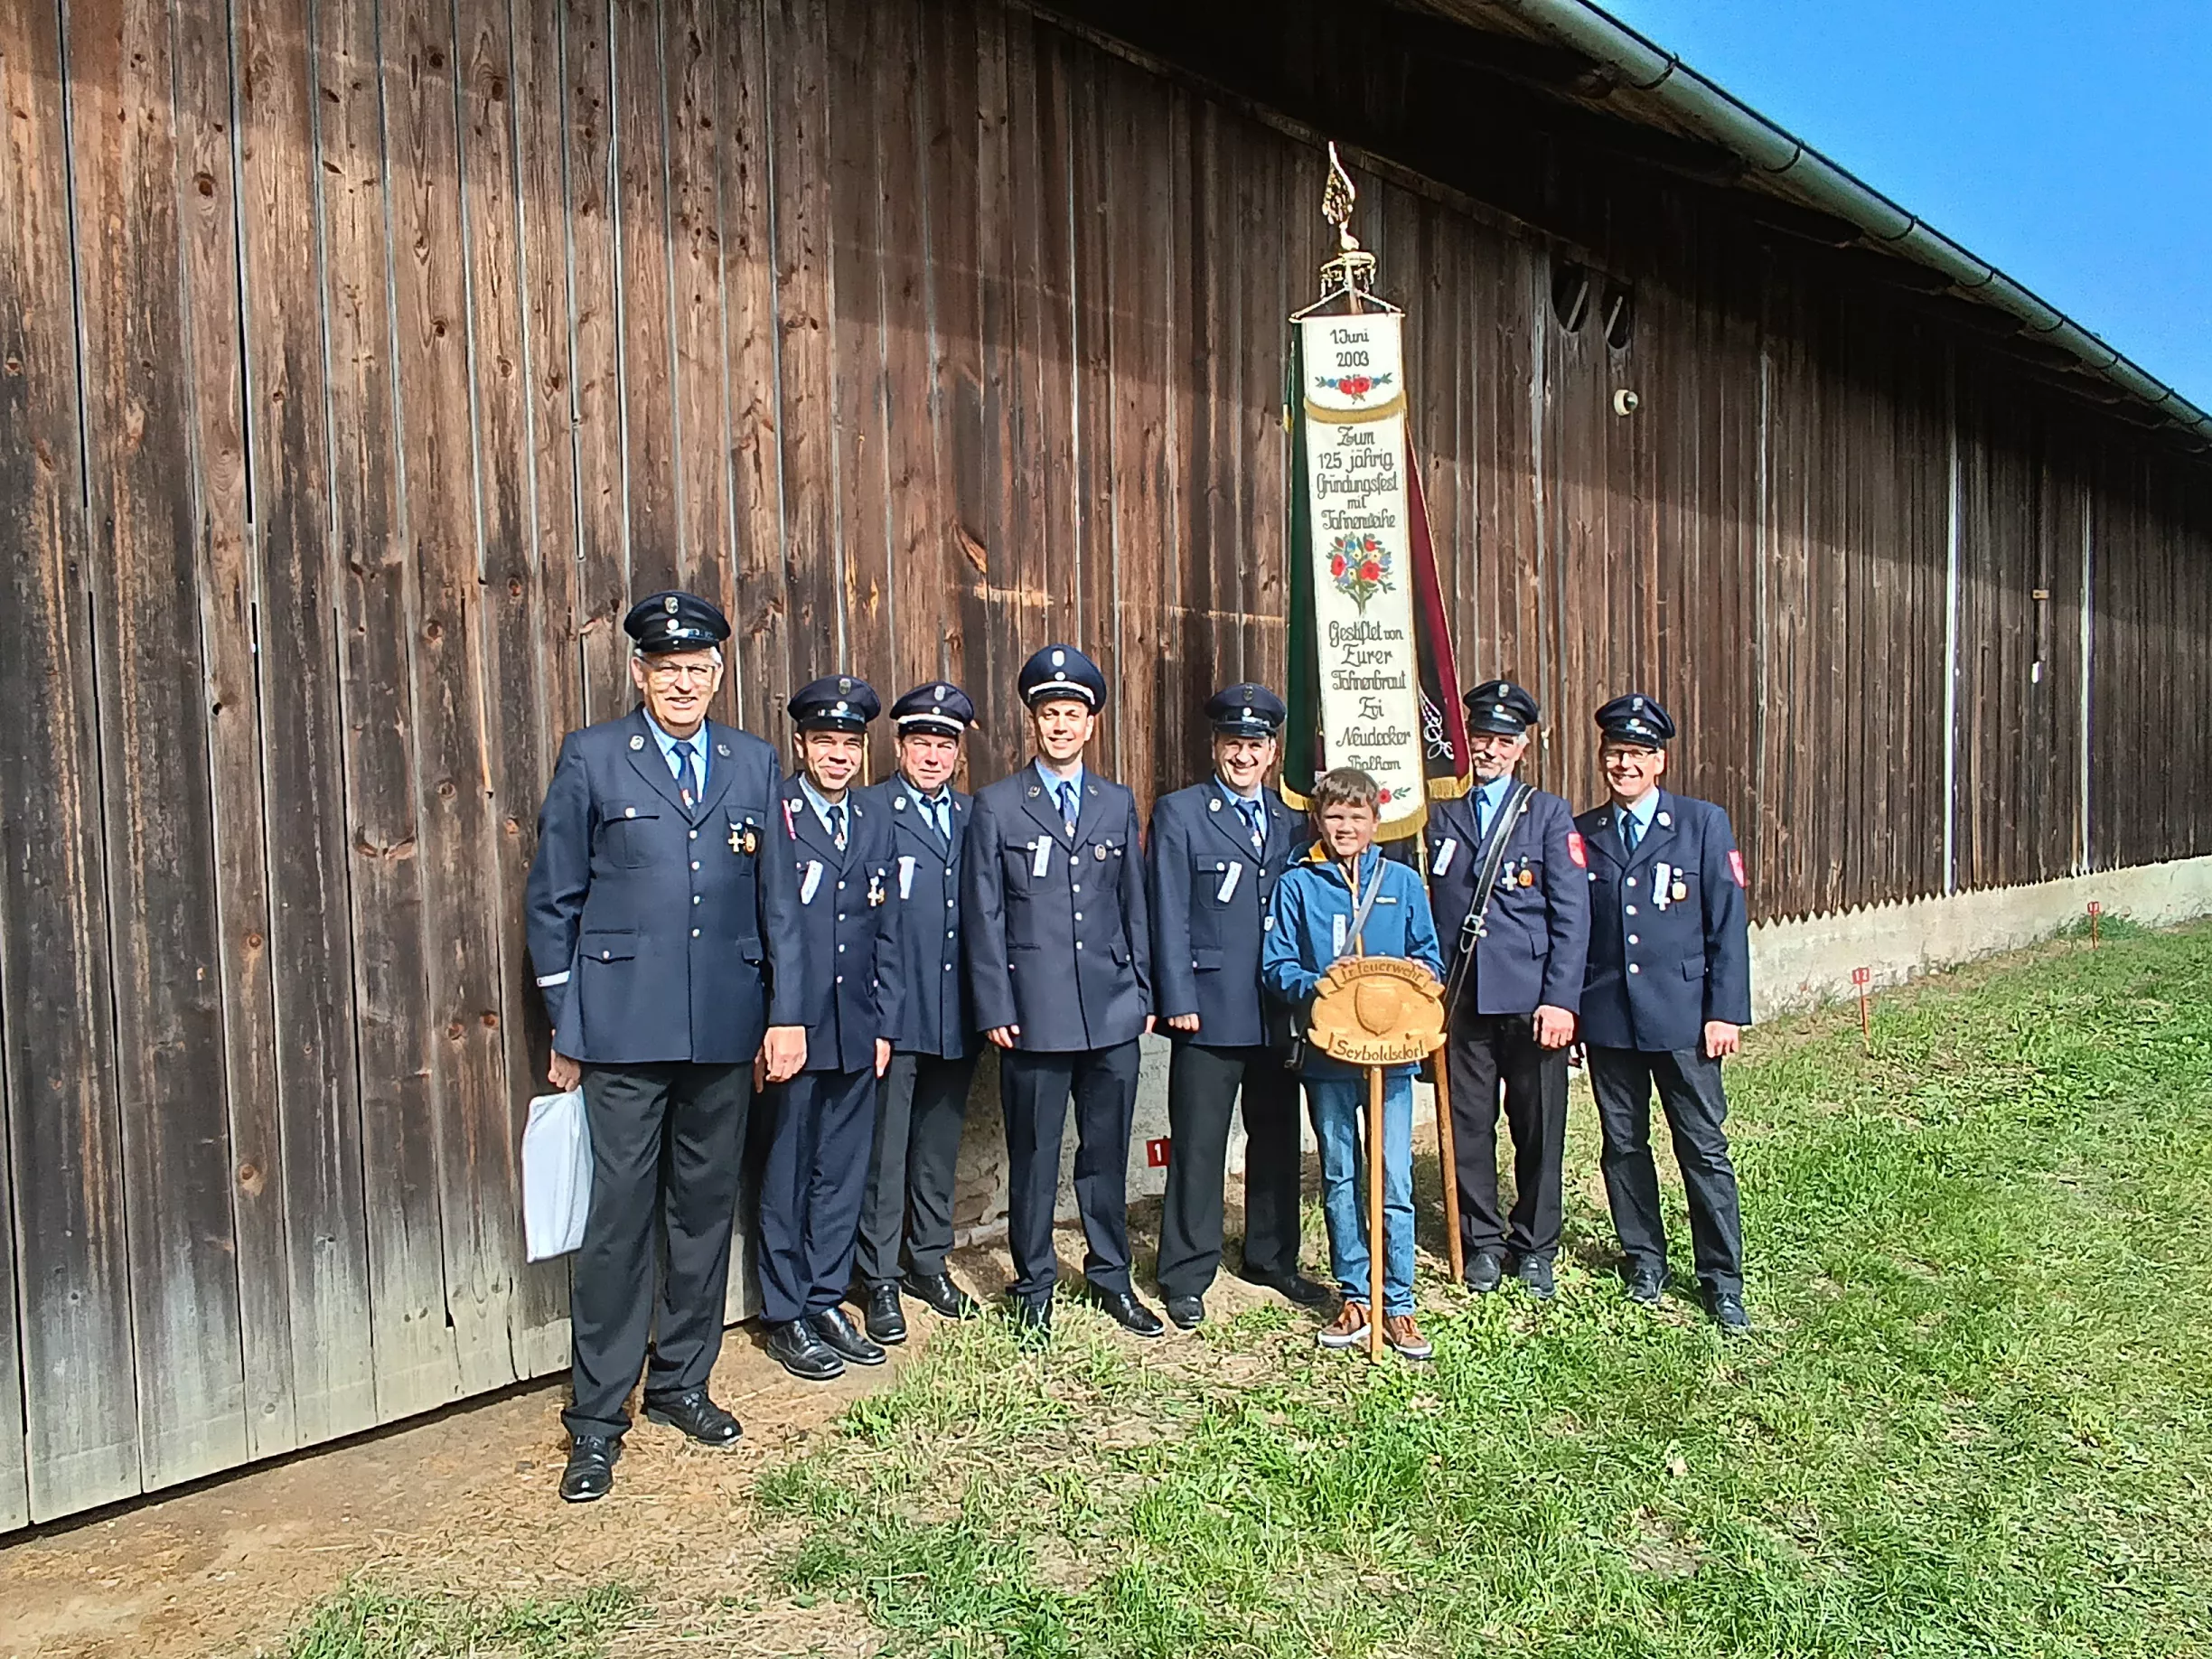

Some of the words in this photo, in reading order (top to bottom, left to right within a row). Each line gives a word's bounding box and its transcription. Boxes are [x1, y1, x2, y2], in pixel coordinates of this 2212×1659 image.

[1336, 351, 1370, 367] 2003
[1336, 426, 1375, 446] Zum
[1317, 452, 1343, 470] 125
[1345, 447, 1394, 473] jährig
[1317, 471, 1399, 500] Gründungsfest
[1346, 495, 1367, 509] mit
[1321, 508, 1396, 530] Fahnenweihe
[1329, 620, 1382, 647] Gestiftet
[1383, 629, 1404, 641] von
[1341, 643, 1393, 667] Eurer
[1331, 670, 1407, 690] Fahnenbraut
[1336, 726, 1411, 747] Neudecker
